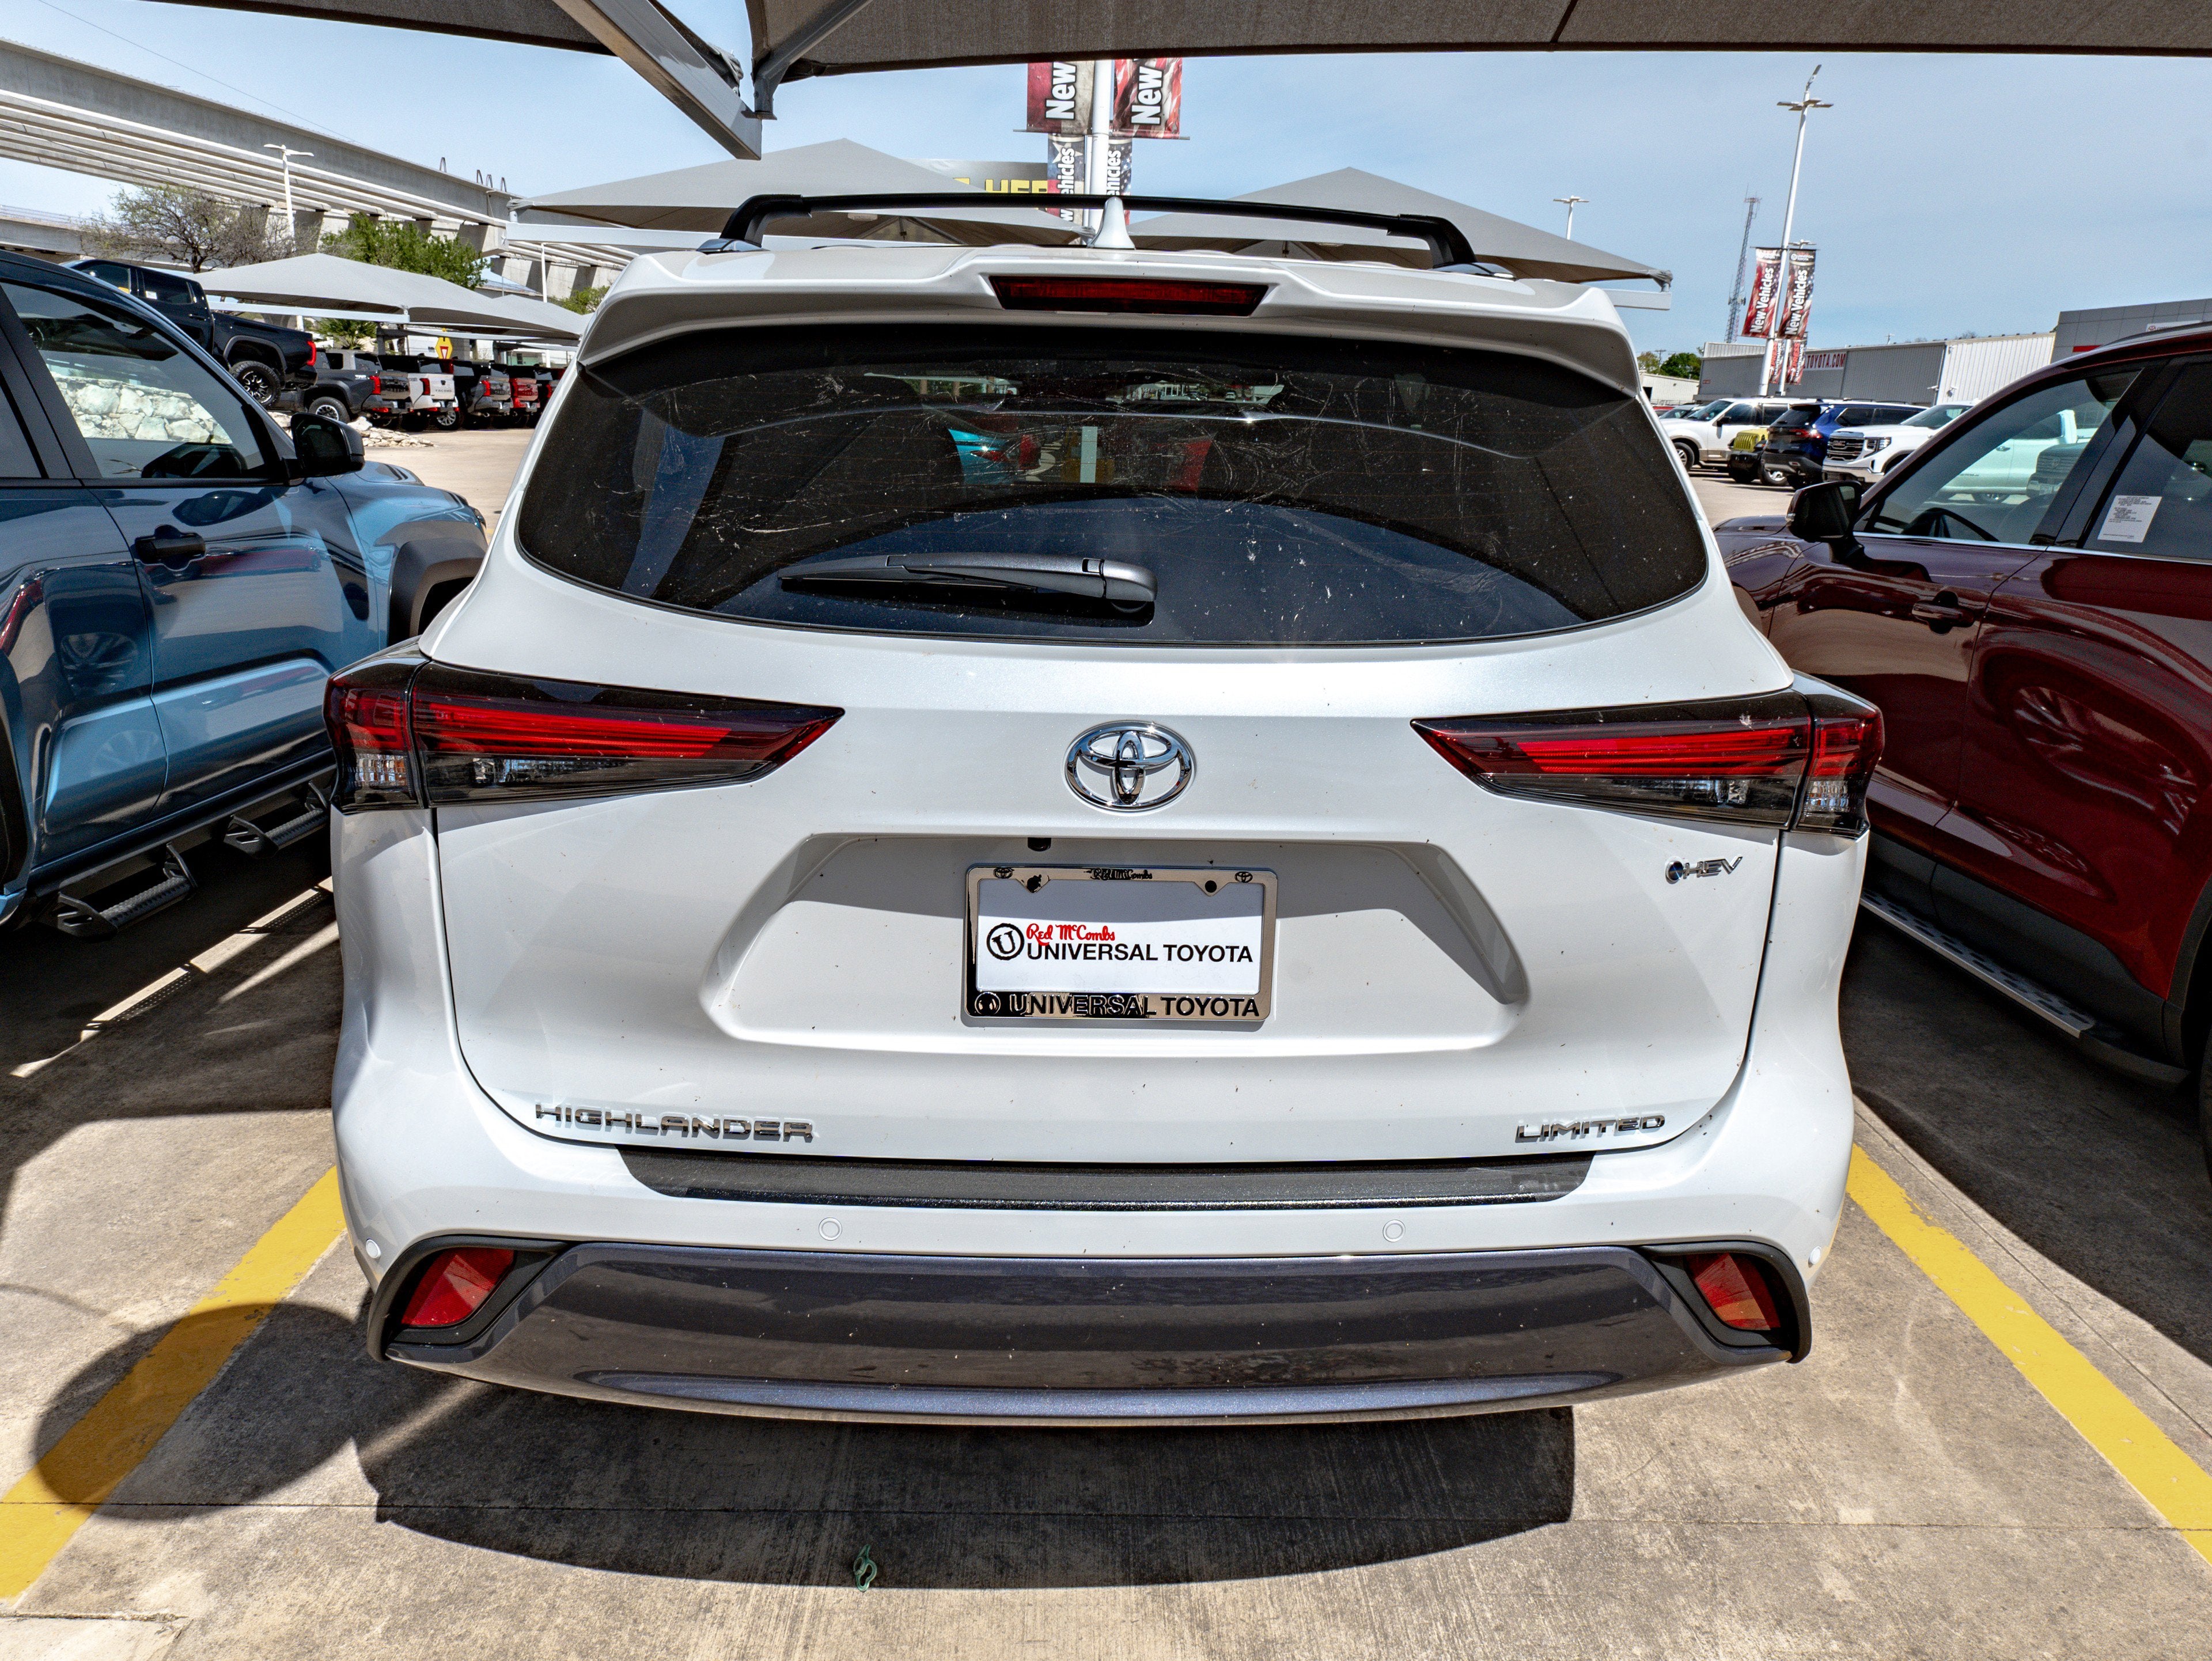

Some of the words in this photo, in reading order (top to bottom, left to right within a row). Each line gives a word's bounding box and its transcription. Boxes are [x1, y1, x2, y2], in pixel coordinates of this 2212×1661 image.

[1045, 62, 1077, 120] New
[1131, 66, 1163, 124] New
[1057, 147, 1075, 194] ehicles
[1107, 150, 1121, 196] ehicles
[1755, 267, 1774, 309] Vehicles
[1790, 270, 1808, 312] Vehicles
[1749, 312, 1767, 333] New
[1785, 314, 1802, 335] New
[1026, 923, 1054, 945] Red
[1055, 924, 1115, 941] McCombs
[1027, 943, 1158, 961] UNIVERSAL
[1163, 944, 1253, 963] TOYOTA
[1009, 994, 1157, 1016] UNIVERSAL
[1160, 996, 1260, 1017] TOYOTA
[535, 1104, 814, 1142] HIGHLANDER
[1517, 1114, 1665, 1141] LIMITED
